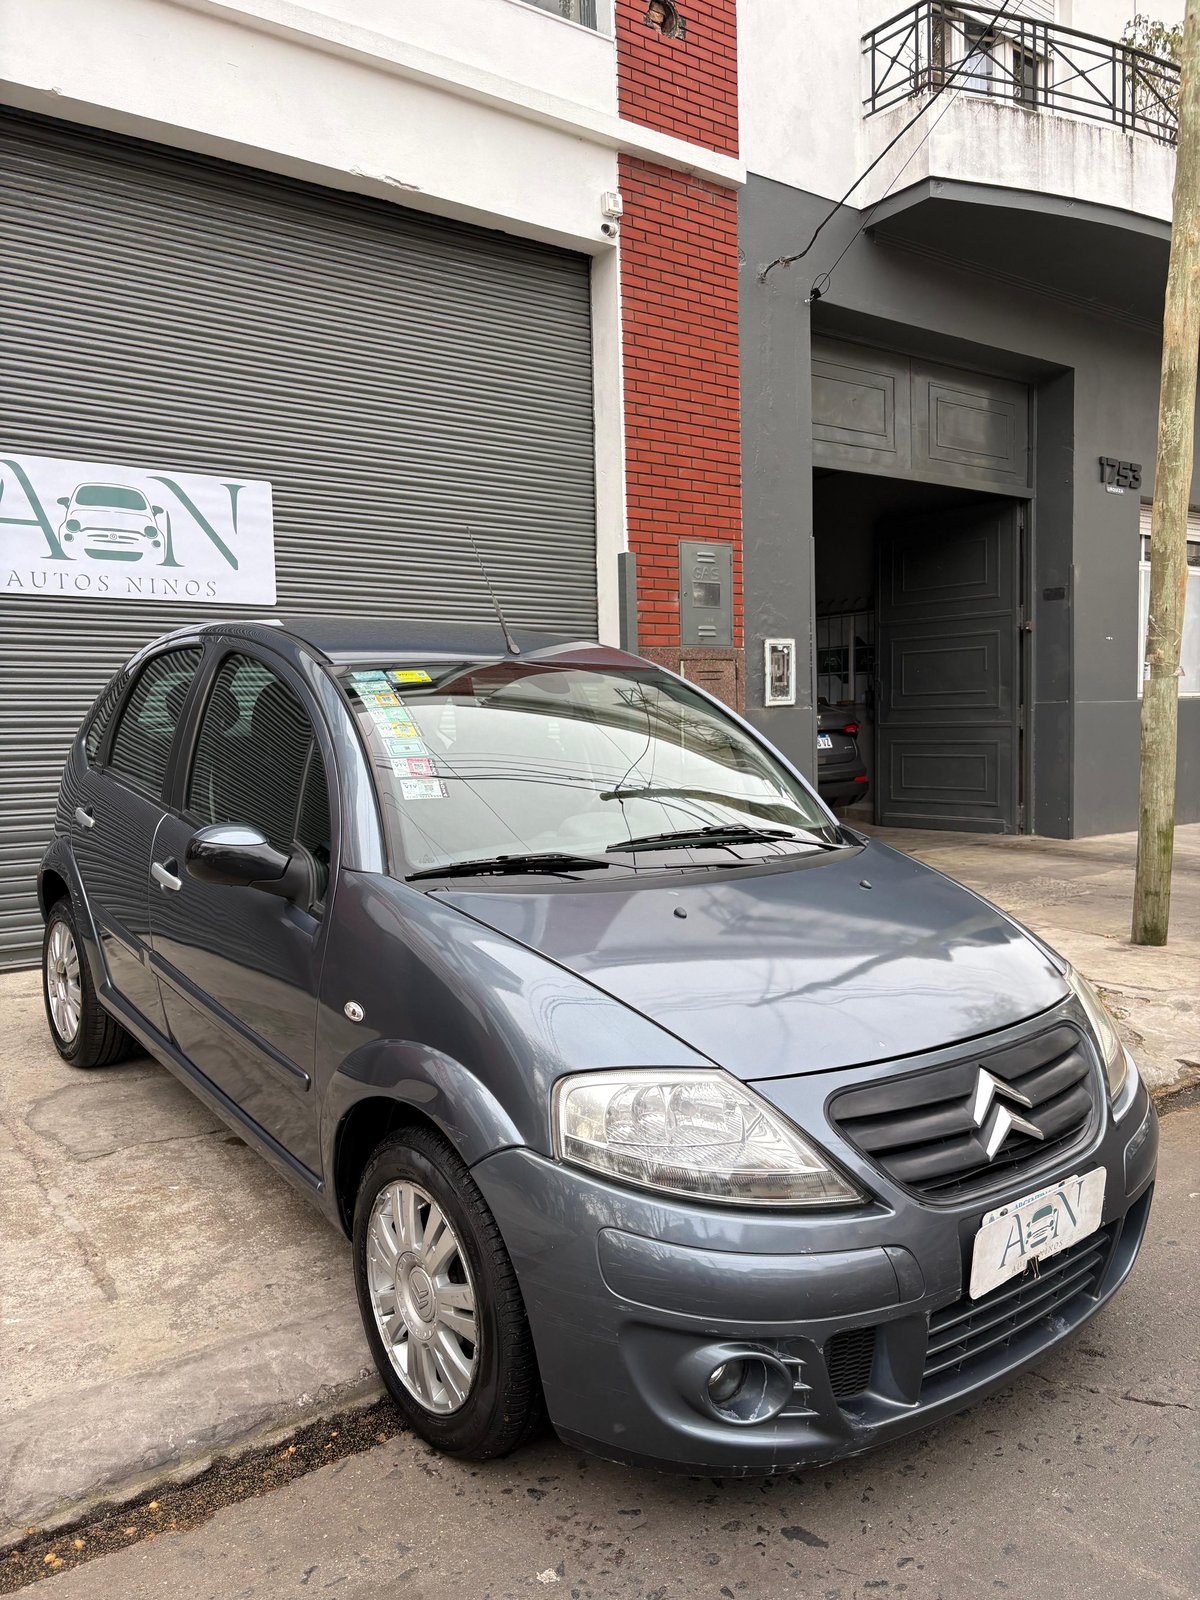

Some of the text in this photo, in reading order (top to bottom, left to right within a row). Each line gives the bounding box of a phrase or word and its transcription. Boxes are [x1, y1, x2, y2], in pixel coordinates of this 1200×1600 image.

[1098, 456, 1142, 489] 1753
[146, 476, 247, 571] N
[7, 569, 217, 597] AUTOS NINOS
[692, 566, 720, 580] GAS
